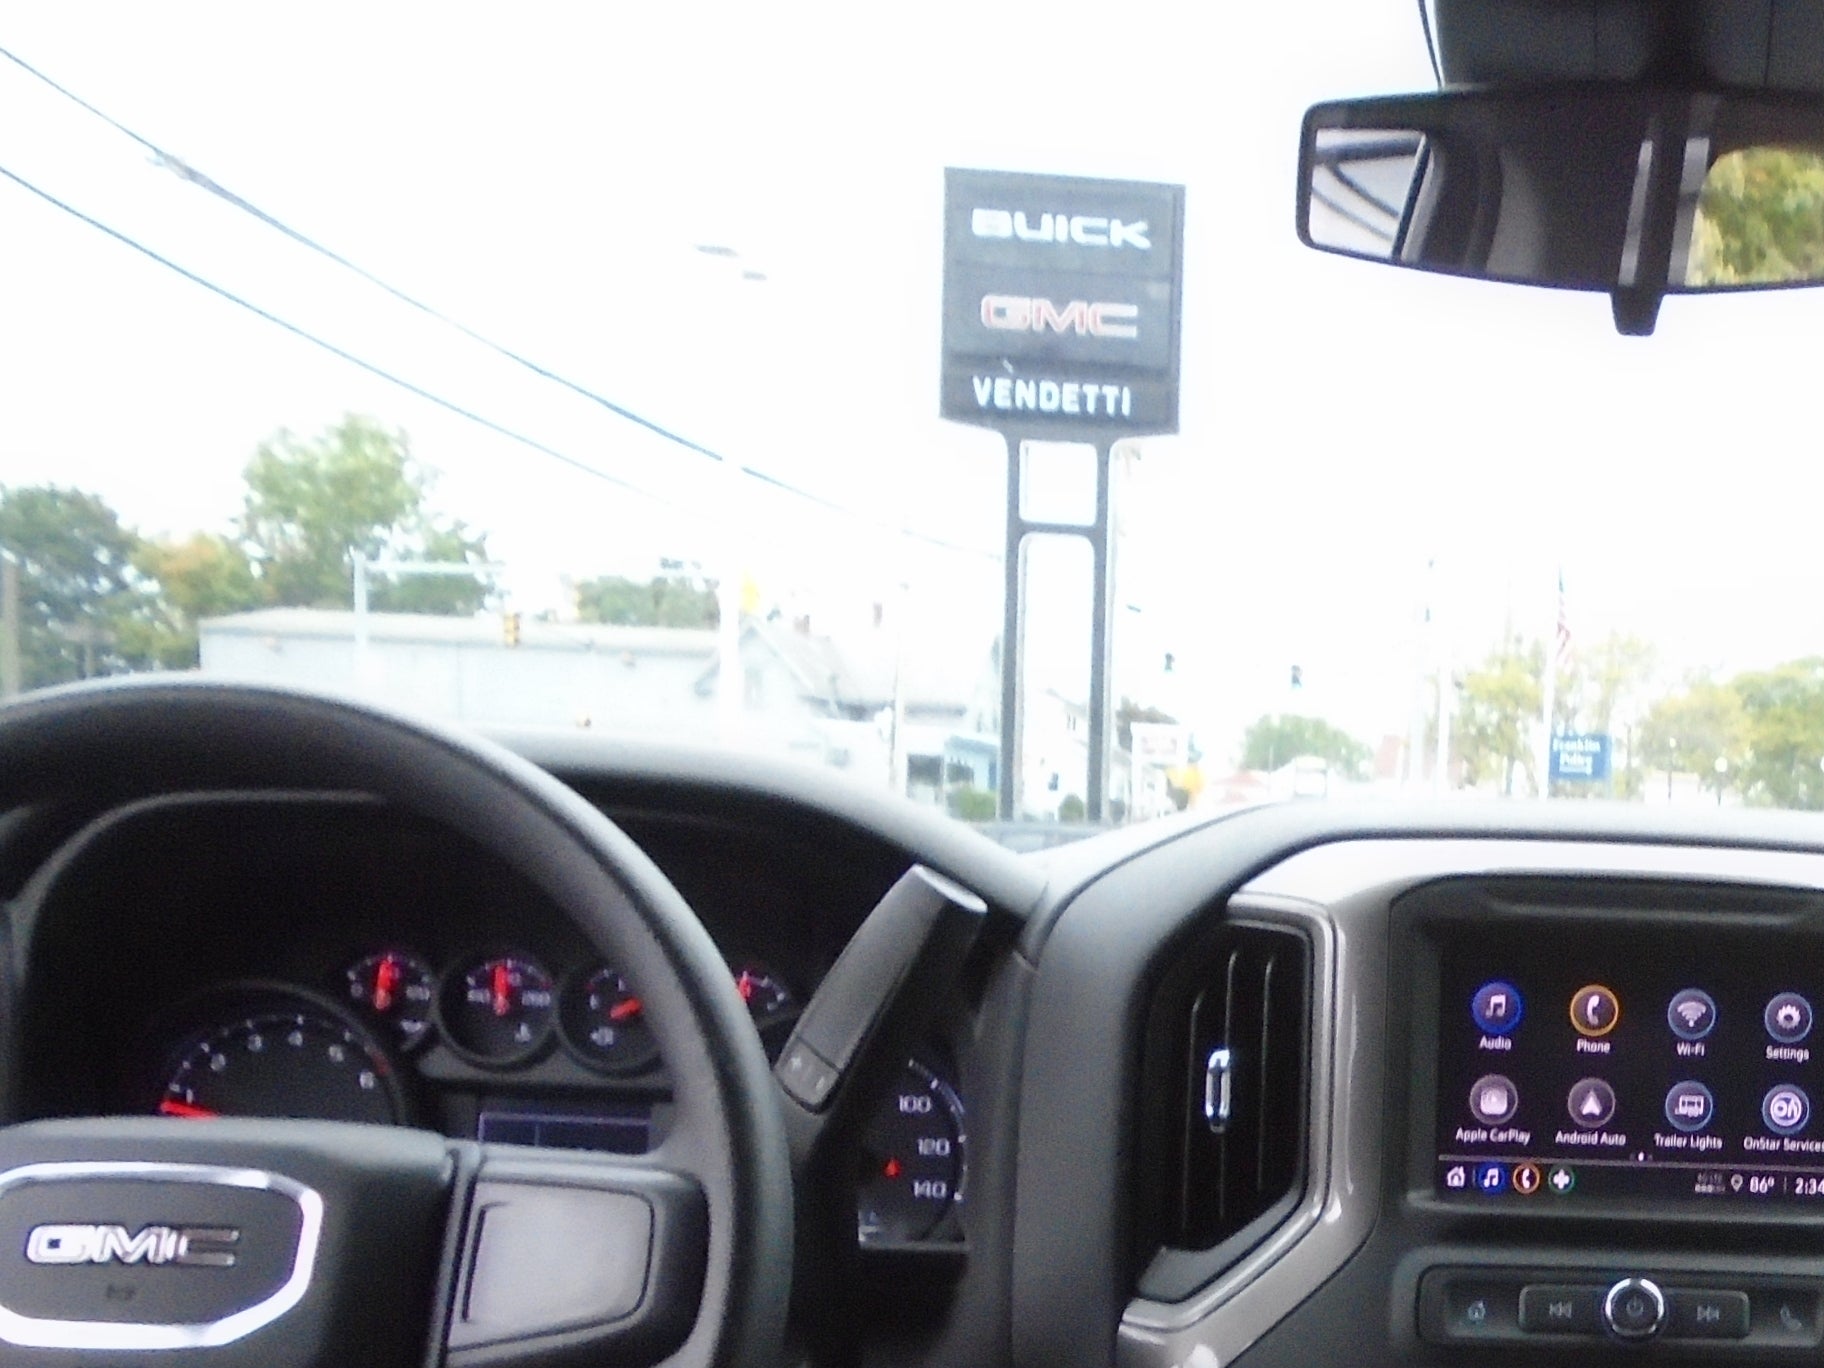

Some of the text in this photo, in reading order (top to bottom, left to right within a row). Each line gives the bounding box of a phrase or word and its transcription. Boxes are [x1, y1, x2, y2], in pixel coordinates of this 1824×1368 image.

[971, 207, 1152, 250] BUICK
[980, 294, 1139, 339] GMC
[972, 375, 1131, 418] VENDETTI
[1479, 1034, 1513, 1051] Audio
[1576, 1038, 1611, 1054] Phone
[1676, 1041, 1705, 1057] Wi-Fi
[1765, 1045, 1811, 1063] Settings
[899, 1095, 932, 1114] 100
[1455, 1126, 1531, 1146] Apple CarPlay
[1555, 1130, 1627, 1146] Android Auto
[1654, 1132, 1723, 1152] Trailer Lights
[1743, 1136, 1781, 1152] OnStar
[913, 1179, 947, 1199] 140
[26, 1223, 241, 1267] GMC
